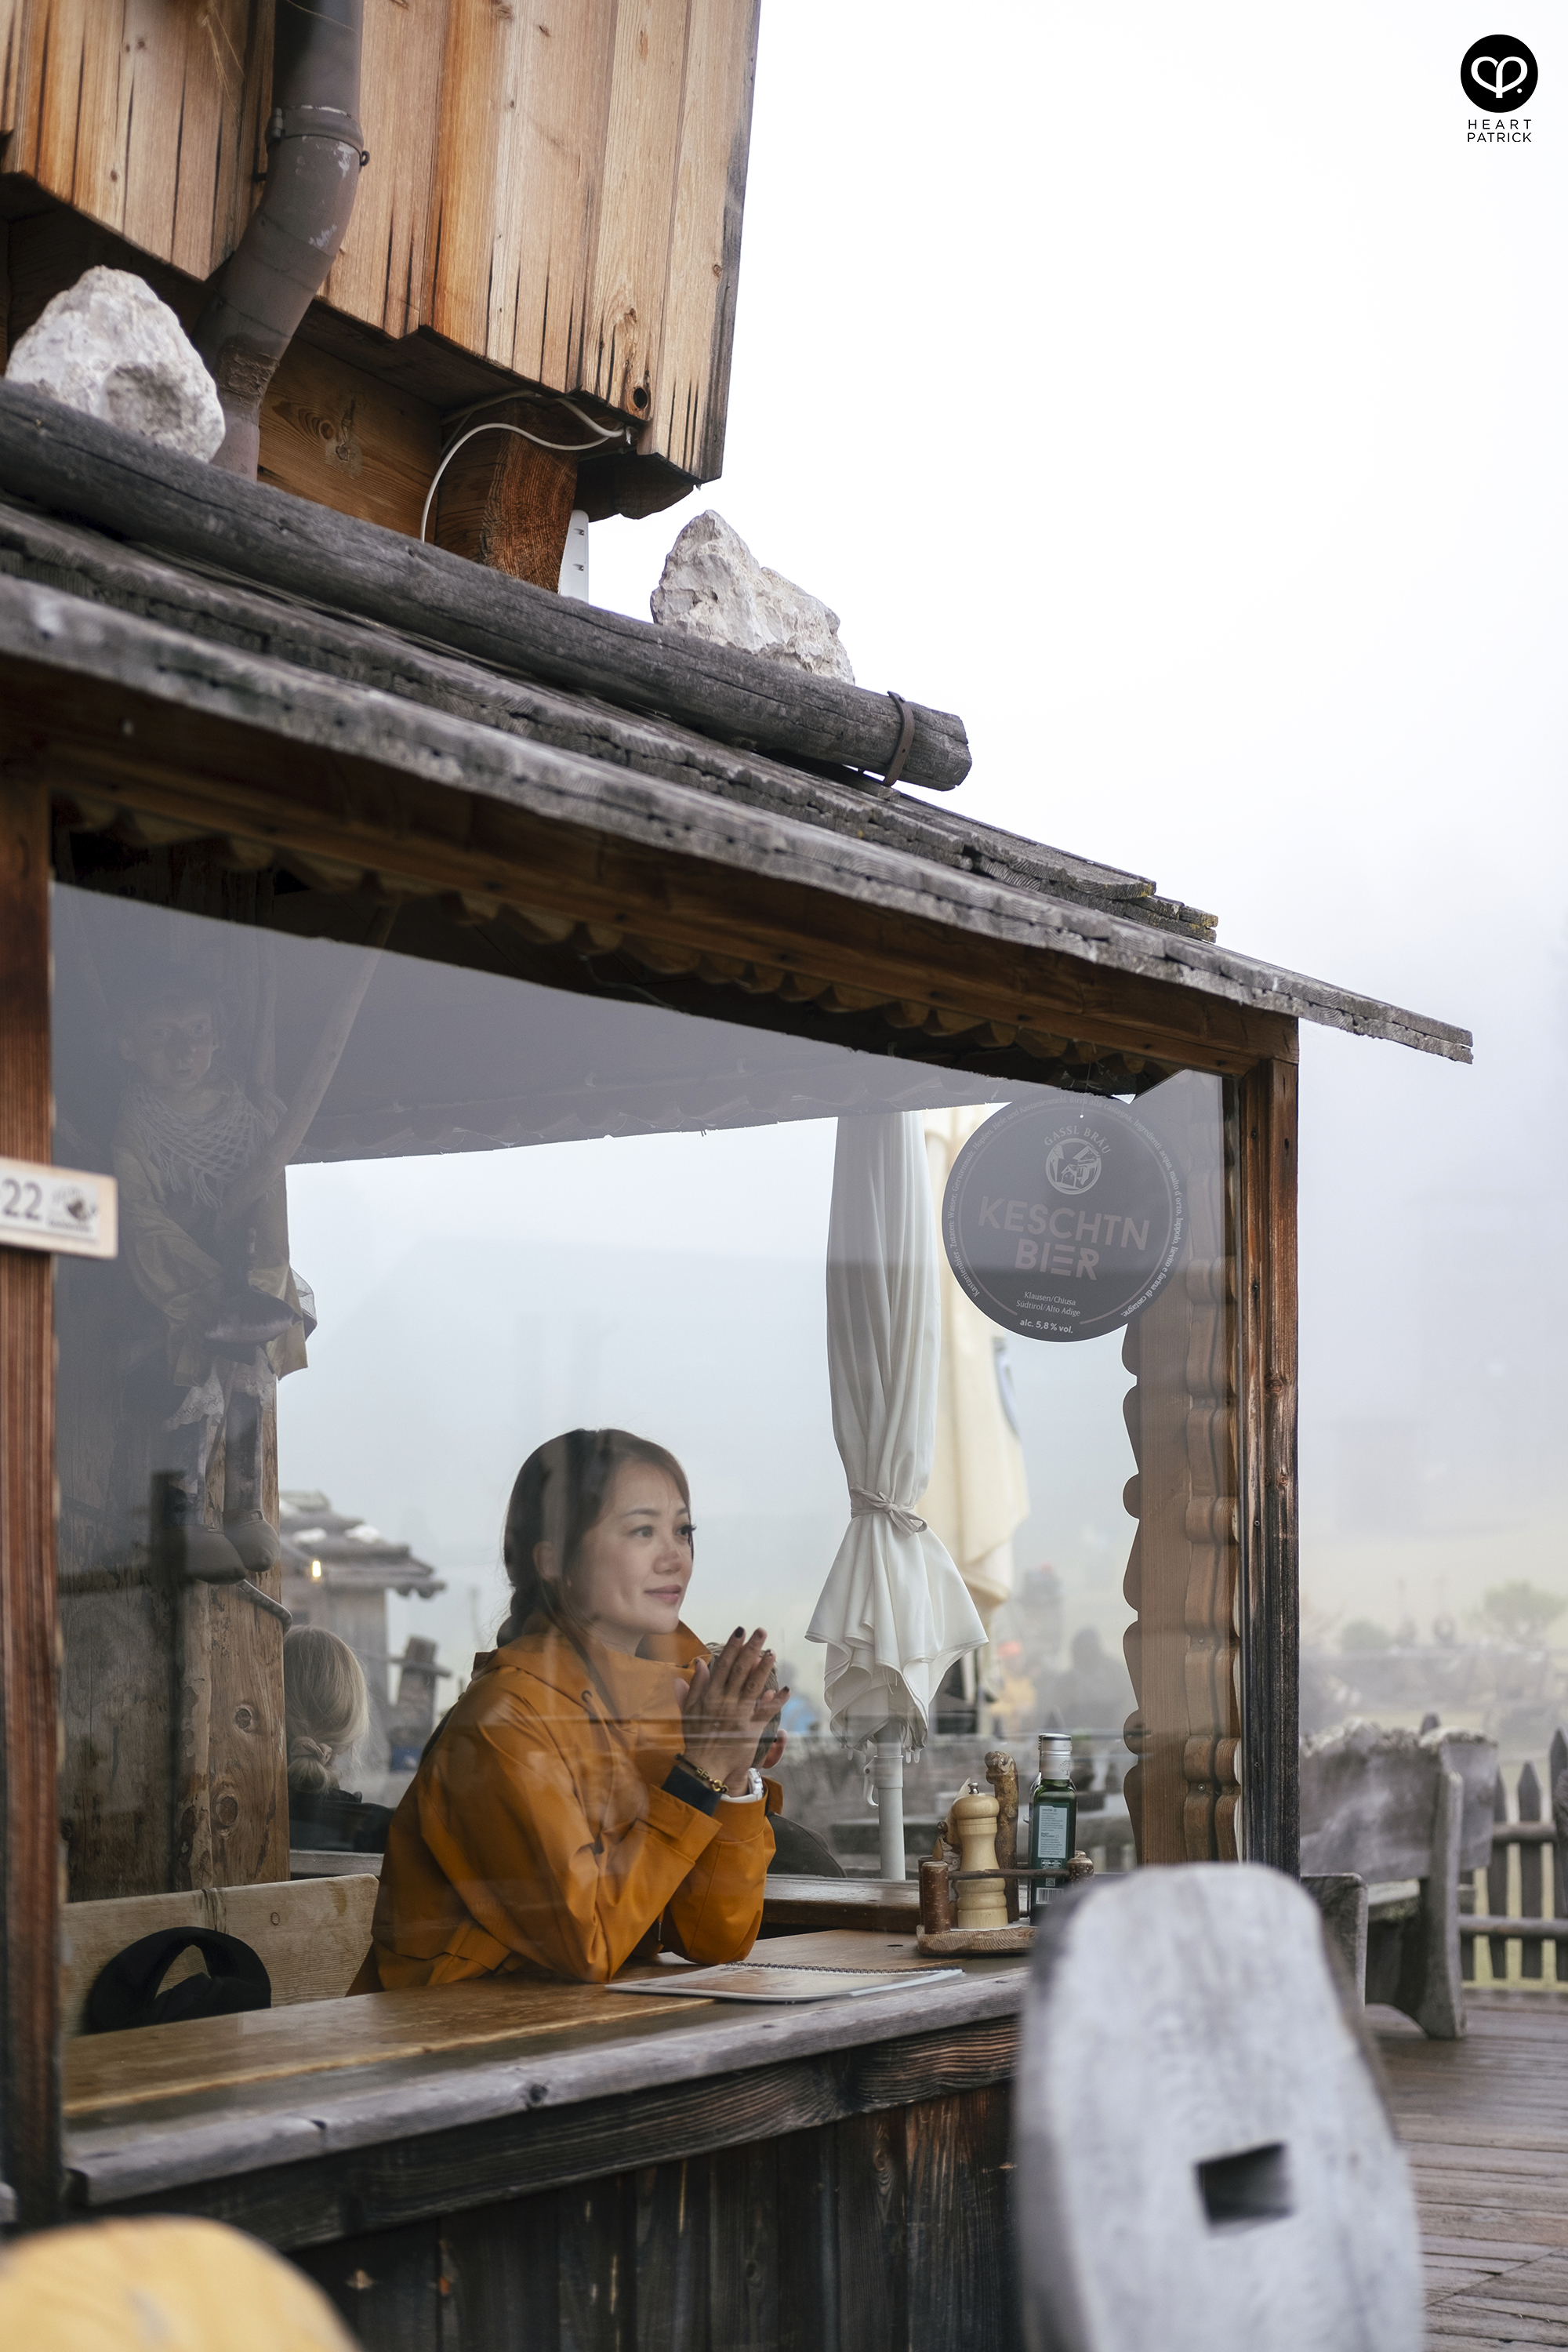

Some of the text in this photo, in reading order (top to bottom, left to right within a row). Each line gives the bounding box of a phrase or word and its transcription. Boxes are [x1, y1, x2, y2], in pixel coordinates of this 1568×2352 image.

[1044, 1125, 1112, 1154] GASSL BRÄU
[1169, 1171, 1180, 1190] malto
[978, 1196, 1150, 1251] KESCHTN
[1014, 1237, 1100, 1281] BIER
[1024, 1290, 1076, 1306] Klausen/Chiusa
[1145, 1289, 1153, 1298] di
[1016, 1300, 1081, 1318] Südtirol/Alto Adige
[1019, 1319, 1034, 1327] alc.
[1058, 1325, 1073, 1334] vol.
